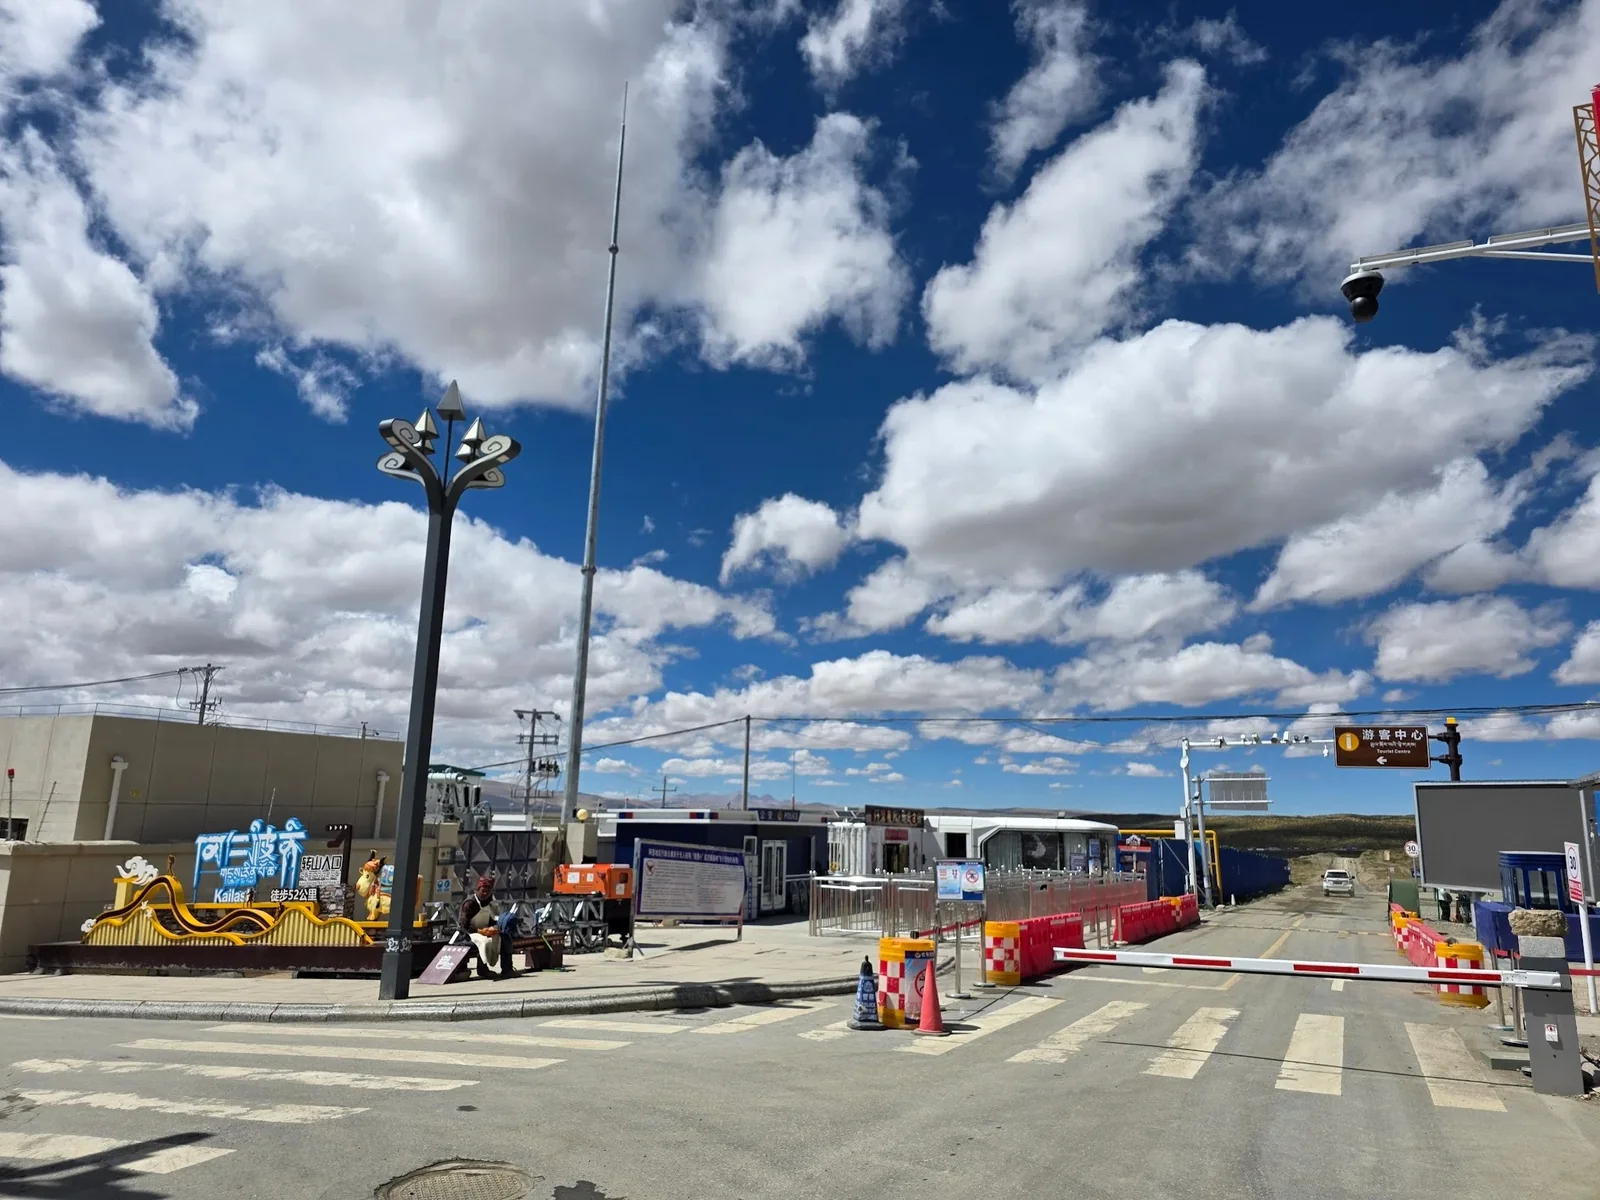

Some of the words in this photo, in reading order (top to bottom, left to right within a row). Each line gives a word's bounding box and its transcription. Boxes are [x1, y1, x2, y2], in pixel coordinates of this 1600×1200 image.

[1362, 729, 1423, 740] 游客中心
[760, 810, 773, 820] 公安
[783, 811, 799, 820] POLICE
[301, 855, 342, 870] 转山入口
[1570, 856, 1577, 870] 30
[270, 888, 317, 902] 徒步52公里
